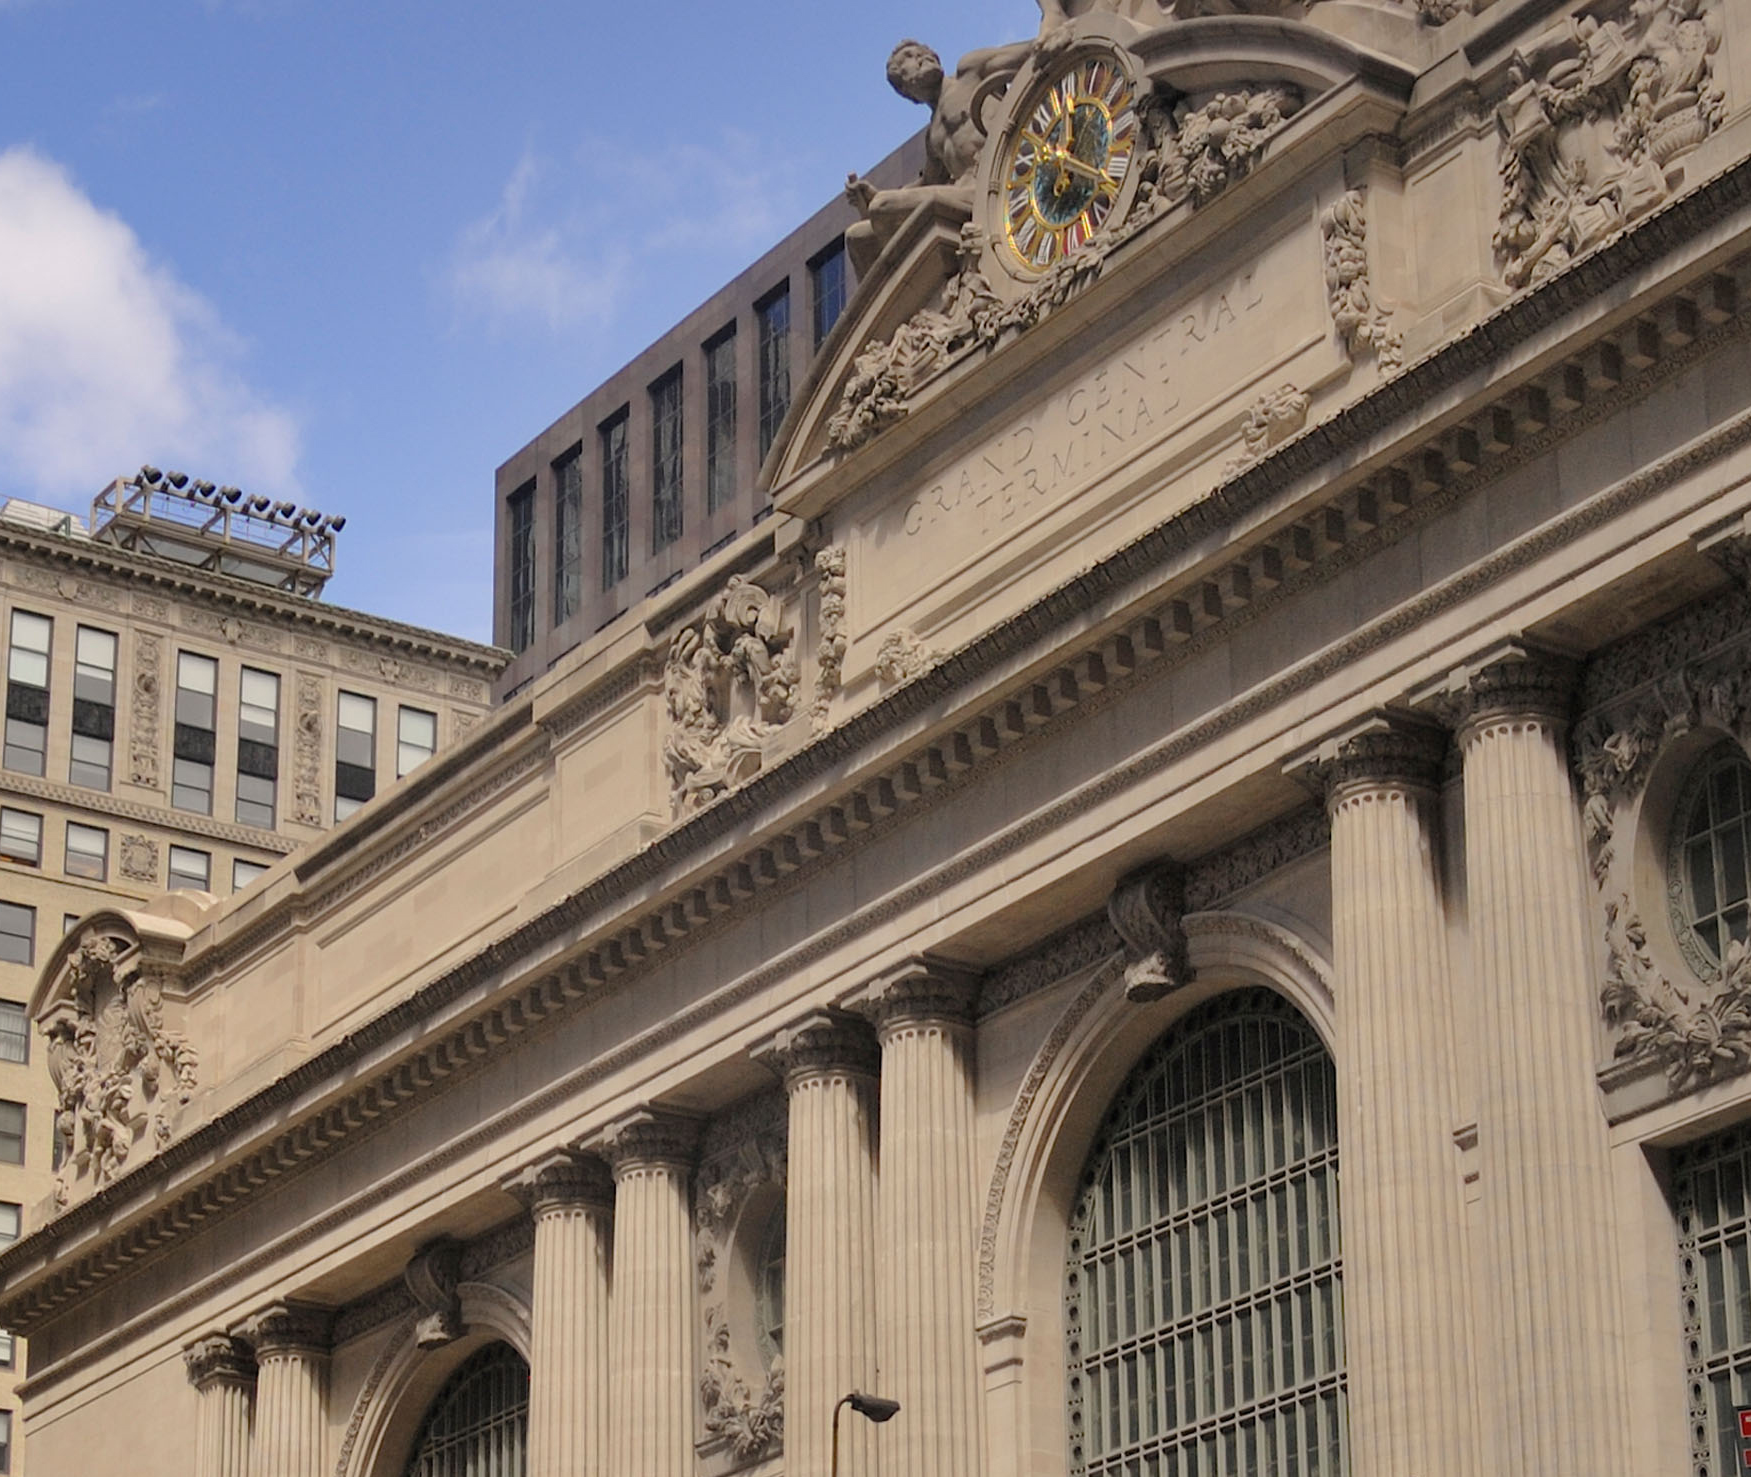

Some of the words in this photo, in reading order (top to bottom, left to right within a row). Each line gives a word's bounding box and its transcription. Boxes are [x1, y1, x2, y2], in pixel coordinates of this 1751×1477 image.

[904, 426, 1034, 536] GRAND
[1067, 274, 1263, 427] CENTRAL
[976, 376, 1180, 535] TERMINAL
